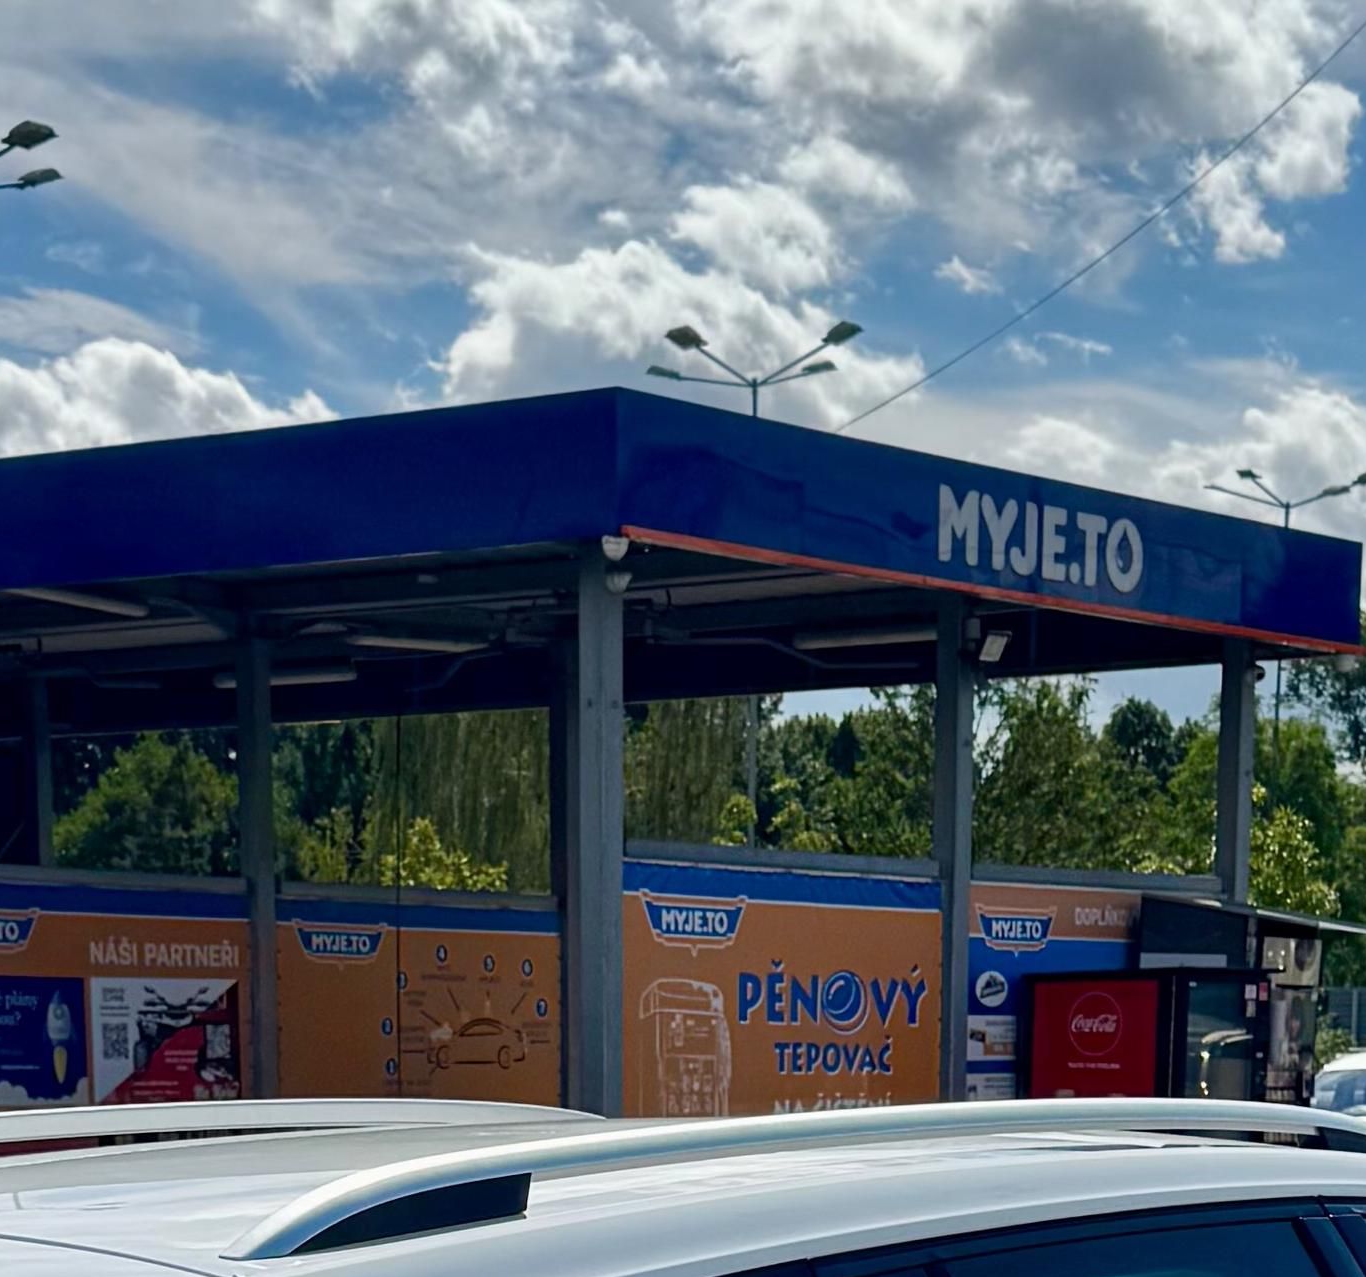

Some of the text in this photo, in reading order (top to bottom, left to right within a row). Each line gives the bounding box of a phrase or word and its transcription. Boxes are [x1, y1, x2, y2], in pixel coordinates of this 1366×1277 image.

[938, 483, 1143, 592] MYJE.TO
[661, 908, 728, 934] MYJE.TO
[991, 919, 1042, 939] MYJE.TO
[311, 934, 370, 953] MYJE.TO
[738, 959, 928, 1035] PĚNOVÝ
[774, 1035, 893, 1076] TEPOVAČ
